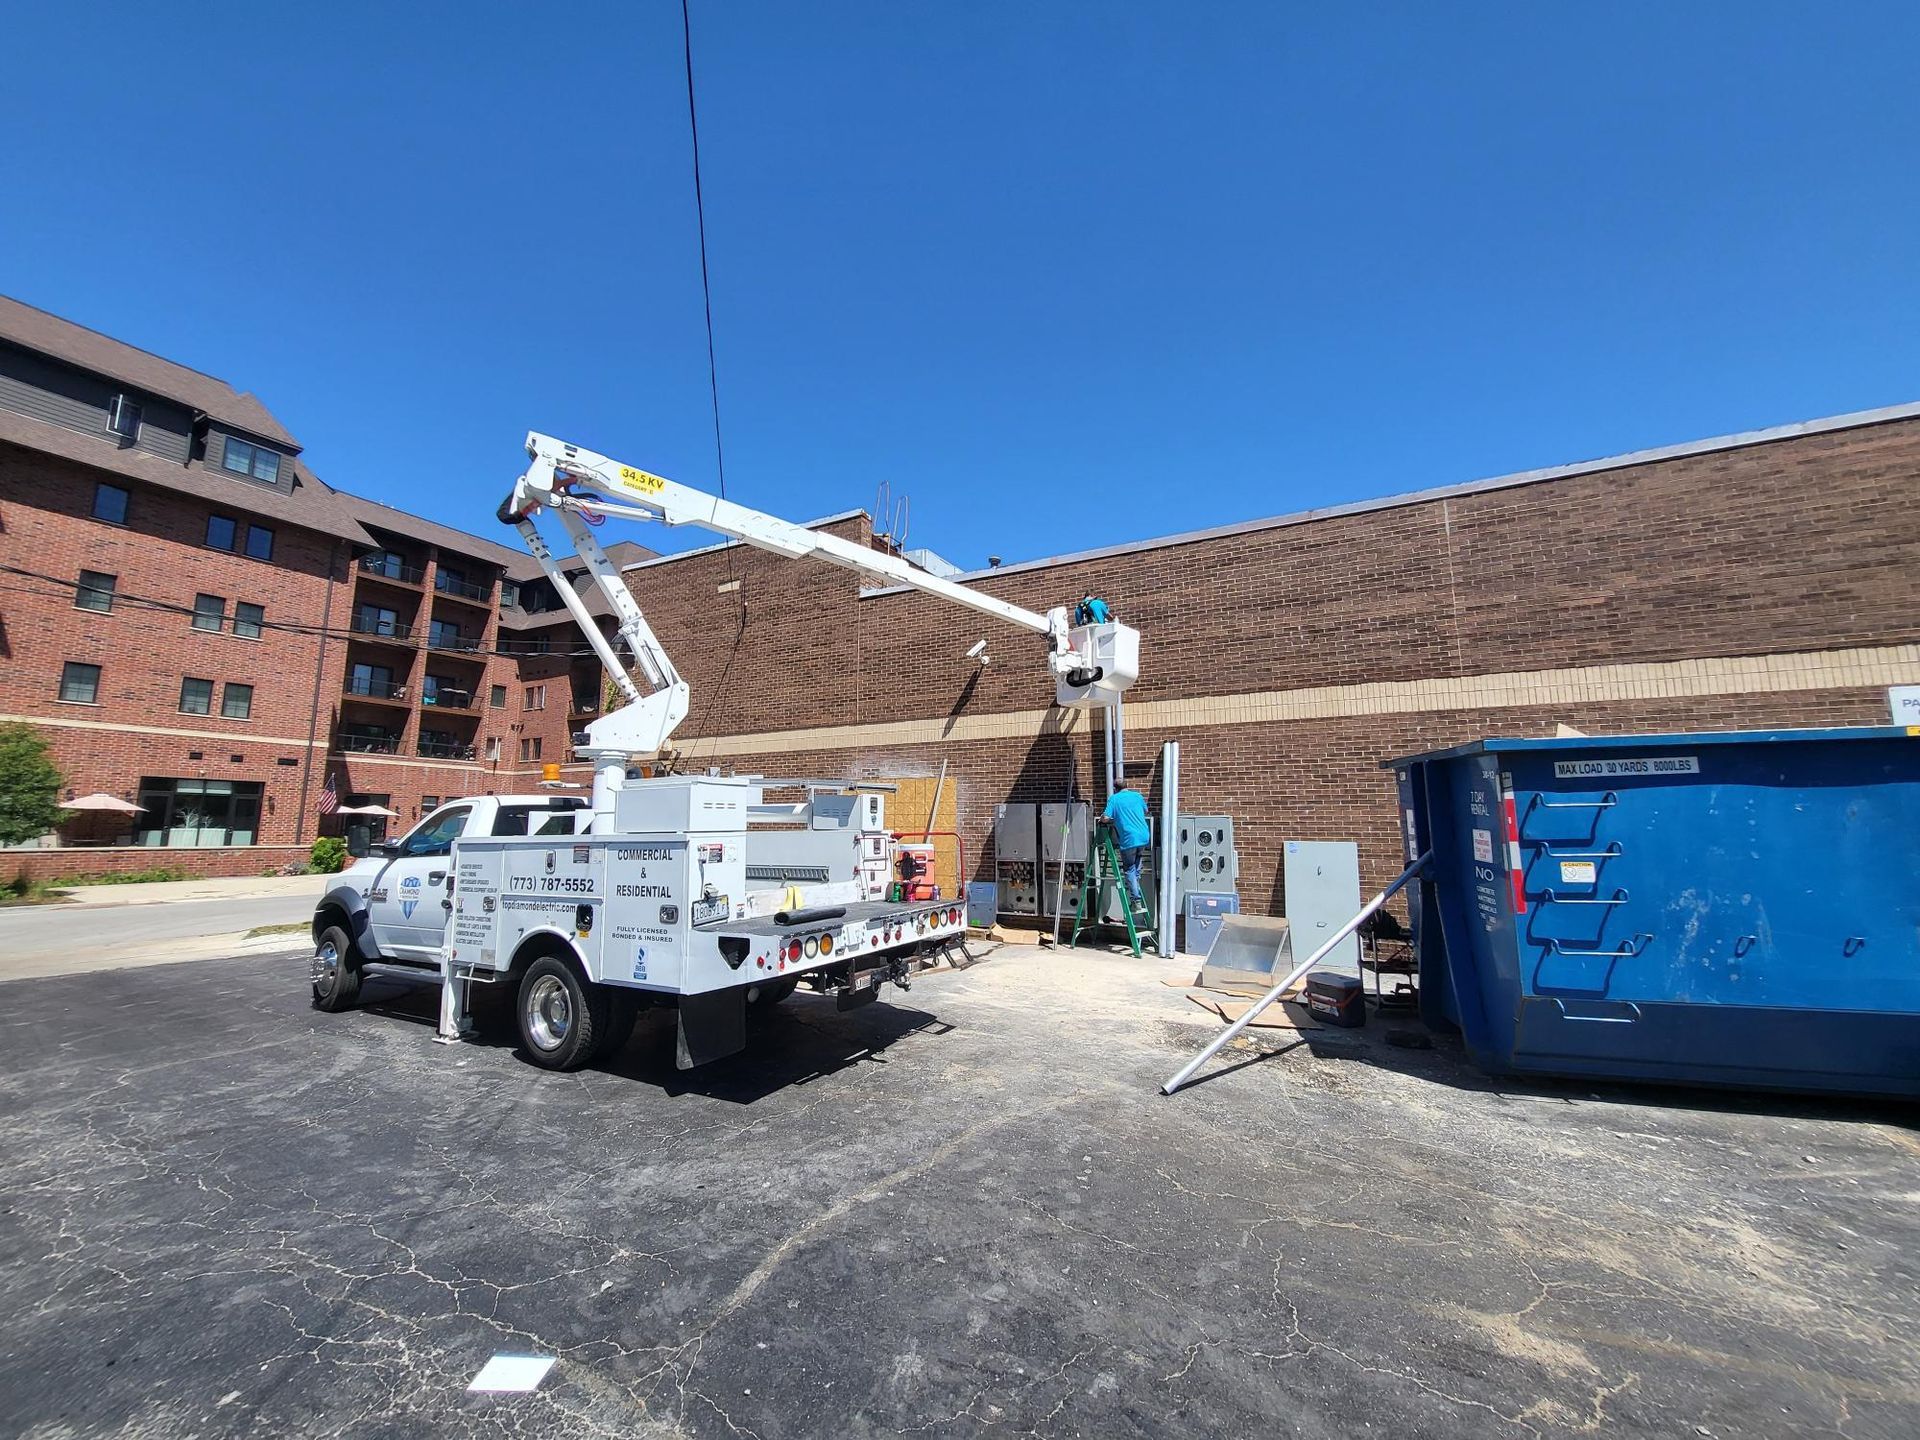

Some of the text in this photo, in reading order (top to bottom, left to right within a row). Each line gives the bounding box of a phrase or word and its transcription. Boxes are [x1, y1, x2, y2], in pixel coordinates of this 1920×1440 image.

[622, 469, 664, 489] 34.5 KV
[1558, 763, 1578, 775] MAX
[1578, 762, 1602, 775] LOAD
[1619, 761, 1648, 773] YARDS
[1653, 759, 1692, 772] 8000LBS
[1474, 791, 1485, 803] DAY
[1470, 803, 1490, 817] RENTAL
[617, 848, 673, 861] COMMERCIAL
[640, 867, 647, 879] &
[1475, 866, 1494, 881] NO
[509, 875, 537, 892] (773)
[540, 877, 594, 893] 787-5552
[616, 884, 672, 899] RESIDENTIAL
[502, 900, 576, 913] topdiamondelectric.com
[616, 925, 668, 935] FULLY LICENSED
[611, 933, 637, 941] BONDED
[644, 935, 673, 943] INSURED
